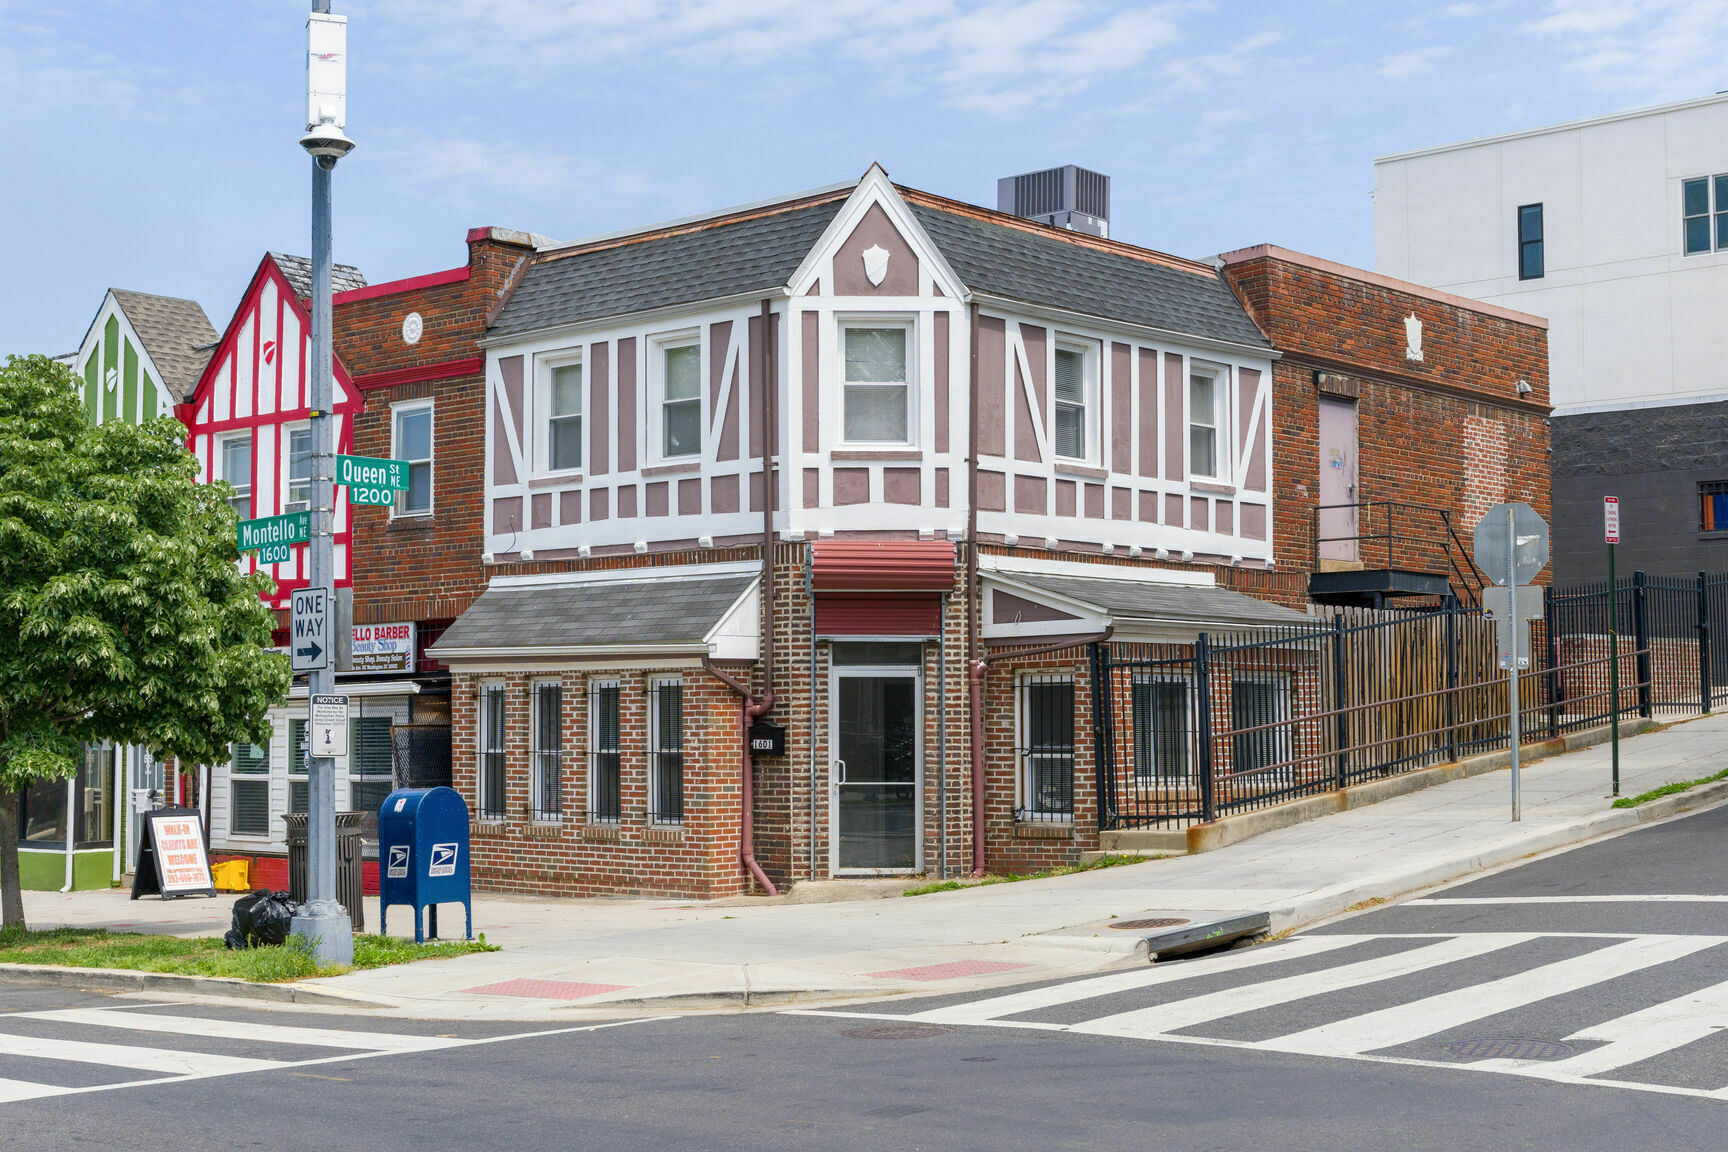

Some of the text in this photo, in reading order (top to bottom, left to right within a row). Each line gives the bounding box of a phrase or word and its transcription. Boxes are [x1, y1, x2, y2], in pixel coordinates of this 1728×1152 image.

[343, 459, 400, 484] Queen St
[390, 475, 400, 487] NE
[353, 487, 391, 504] 1200
[243, 514, 307, 547] Montello Ave
[299, 527, 307, 539] NE
[262, 545, 288, 561] 1600
[295, 595, 323, 615] ONE
[295, 617, 323, 638] WAY
[374, 625, 410, 640] BARBER
[377, 638, 398, 653] Shop
[316, 696, 344, 704] NOTICE
[754, 740, 772, 749] 1601
[167, 853, 198, 866] WELCOME
